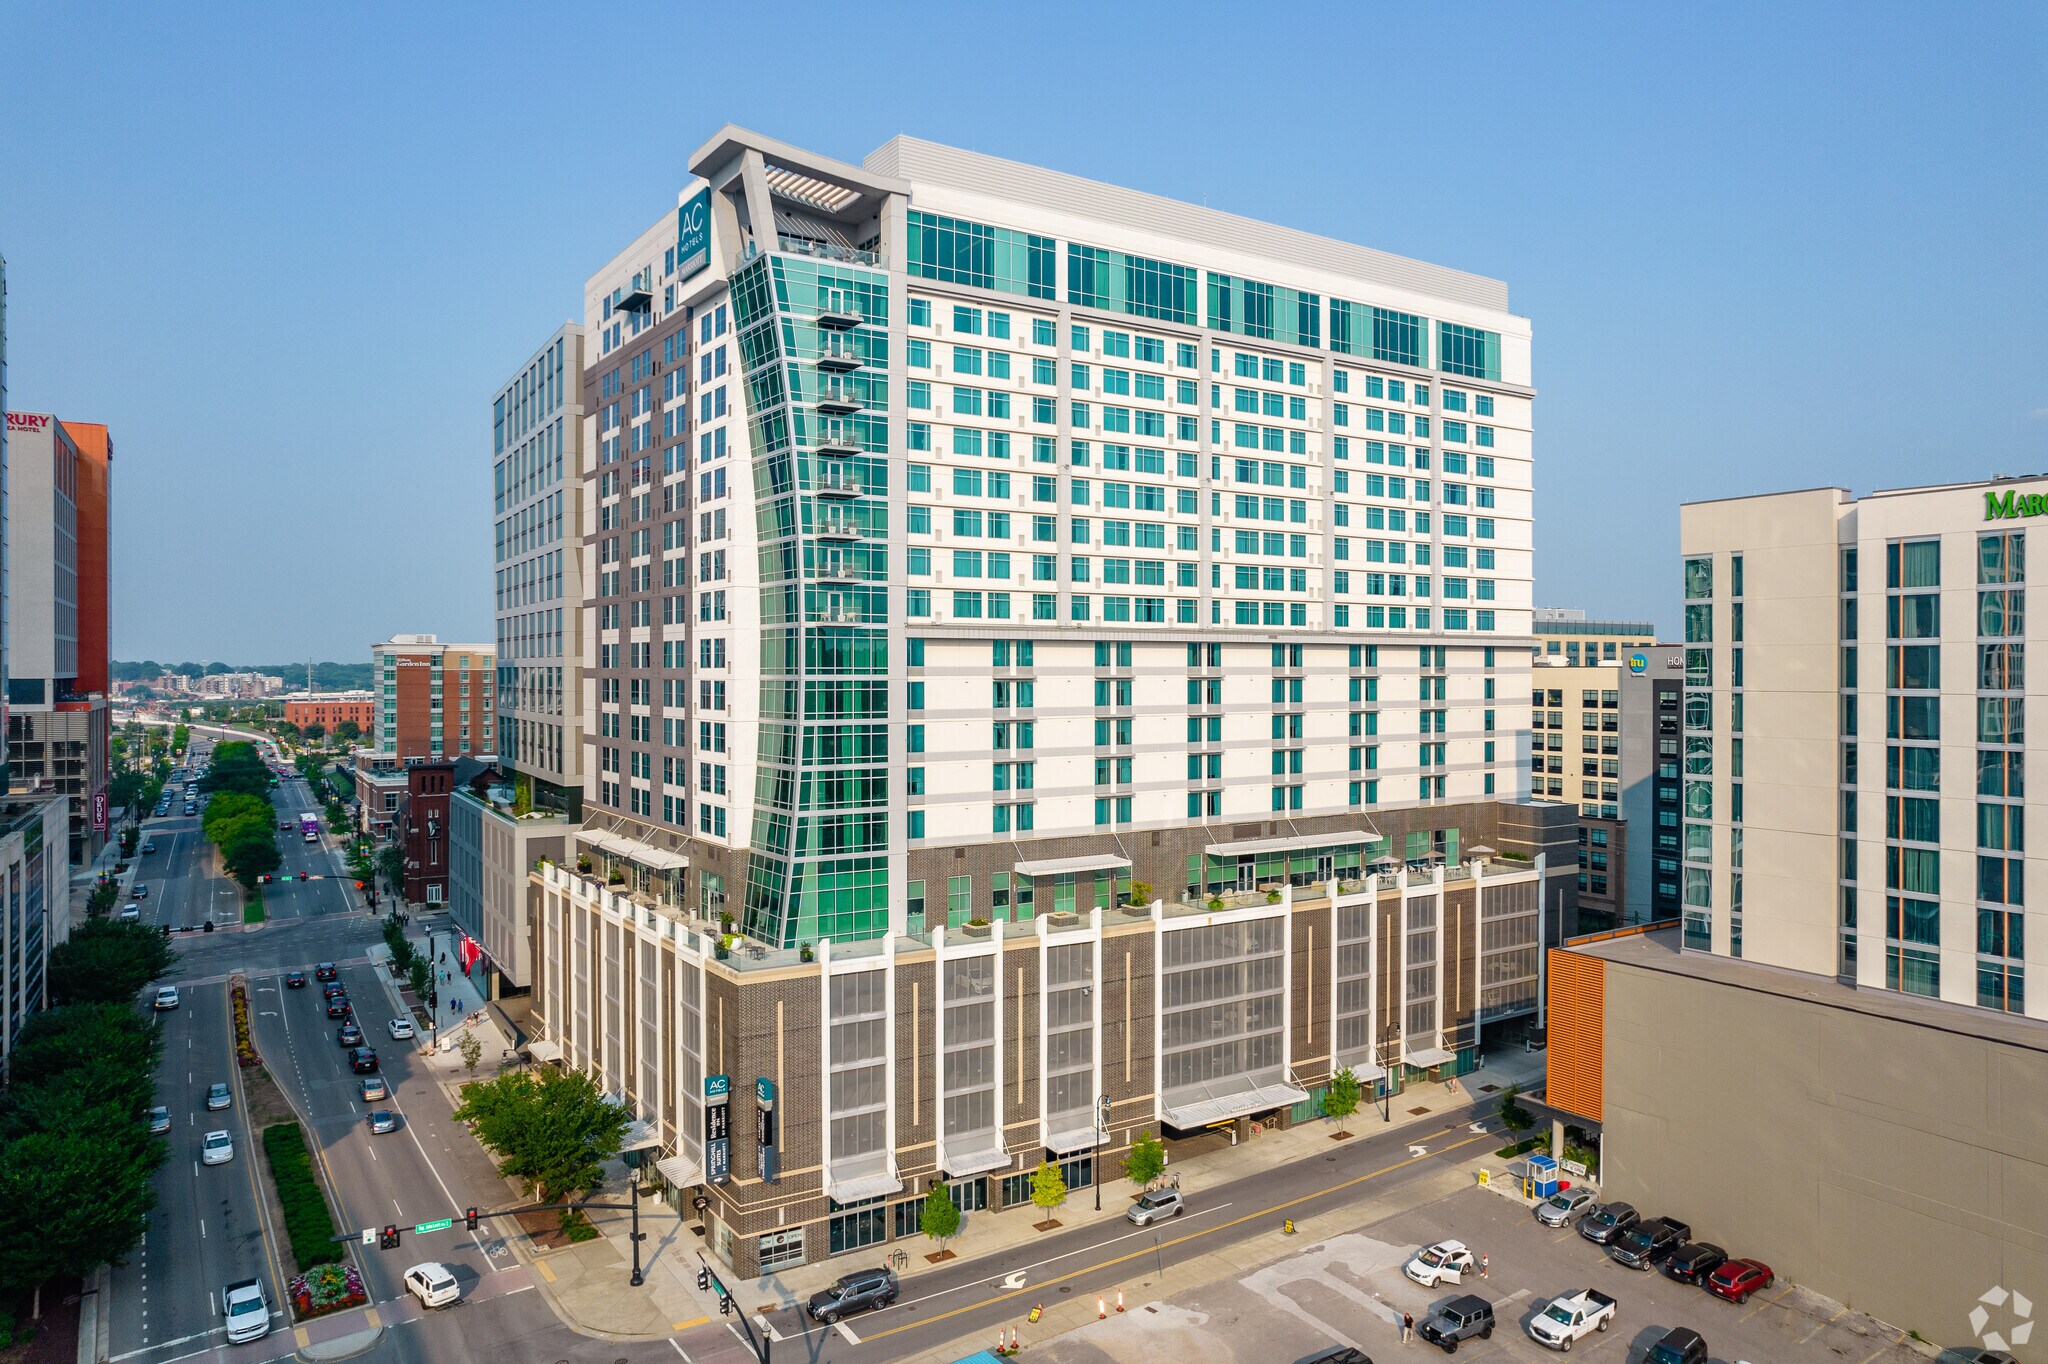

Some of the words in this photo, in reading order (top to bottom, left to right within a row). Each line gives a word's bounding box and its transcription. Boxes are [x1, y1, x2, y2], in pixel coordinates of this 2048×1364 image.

[681, 202, 703, 241] AC
[681, 232, 704, 254] HOTELS
[1984, 489, 2048, 520] MAR
[709, 1079, 726, 1090] AC
